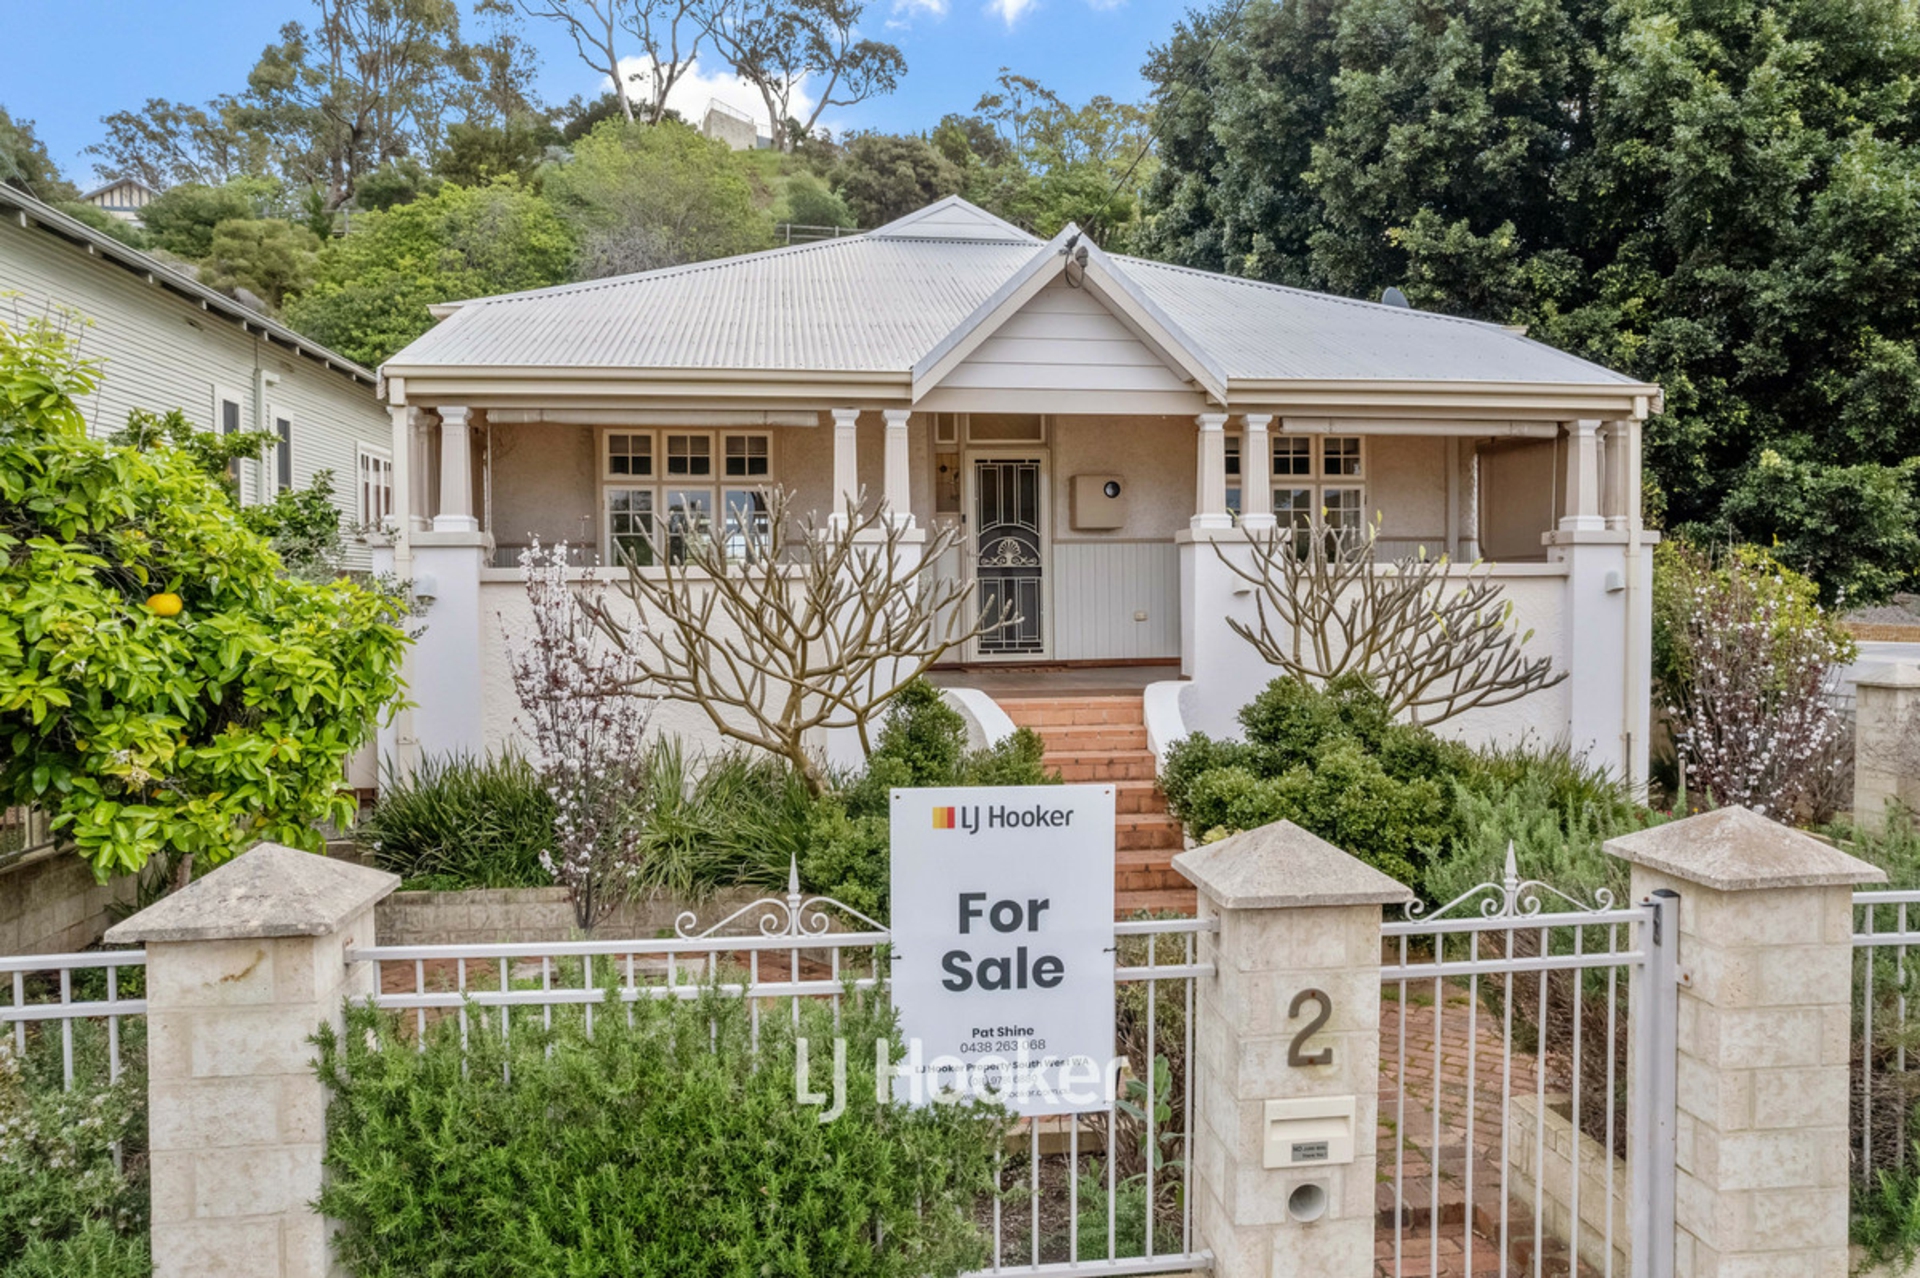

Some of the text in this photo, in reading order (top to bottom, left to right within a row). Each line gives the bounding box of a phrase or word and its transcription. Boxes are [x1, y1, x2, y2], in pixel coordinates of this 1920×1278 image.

[961, 804, 1074, 835] LJ Hooker
[958, 892, 1050, 934] For
[941, 946, 1065, 992] Sale
[972, 1025, 1035, 1038] Pat Shine
[1287, 988, 1333, 1067] 2
[960, 1038, 1046, 1053] 0438 263 068
[966, 1061, 1011, 1074] Property
[1012, 1059, 1042, 1069] South
